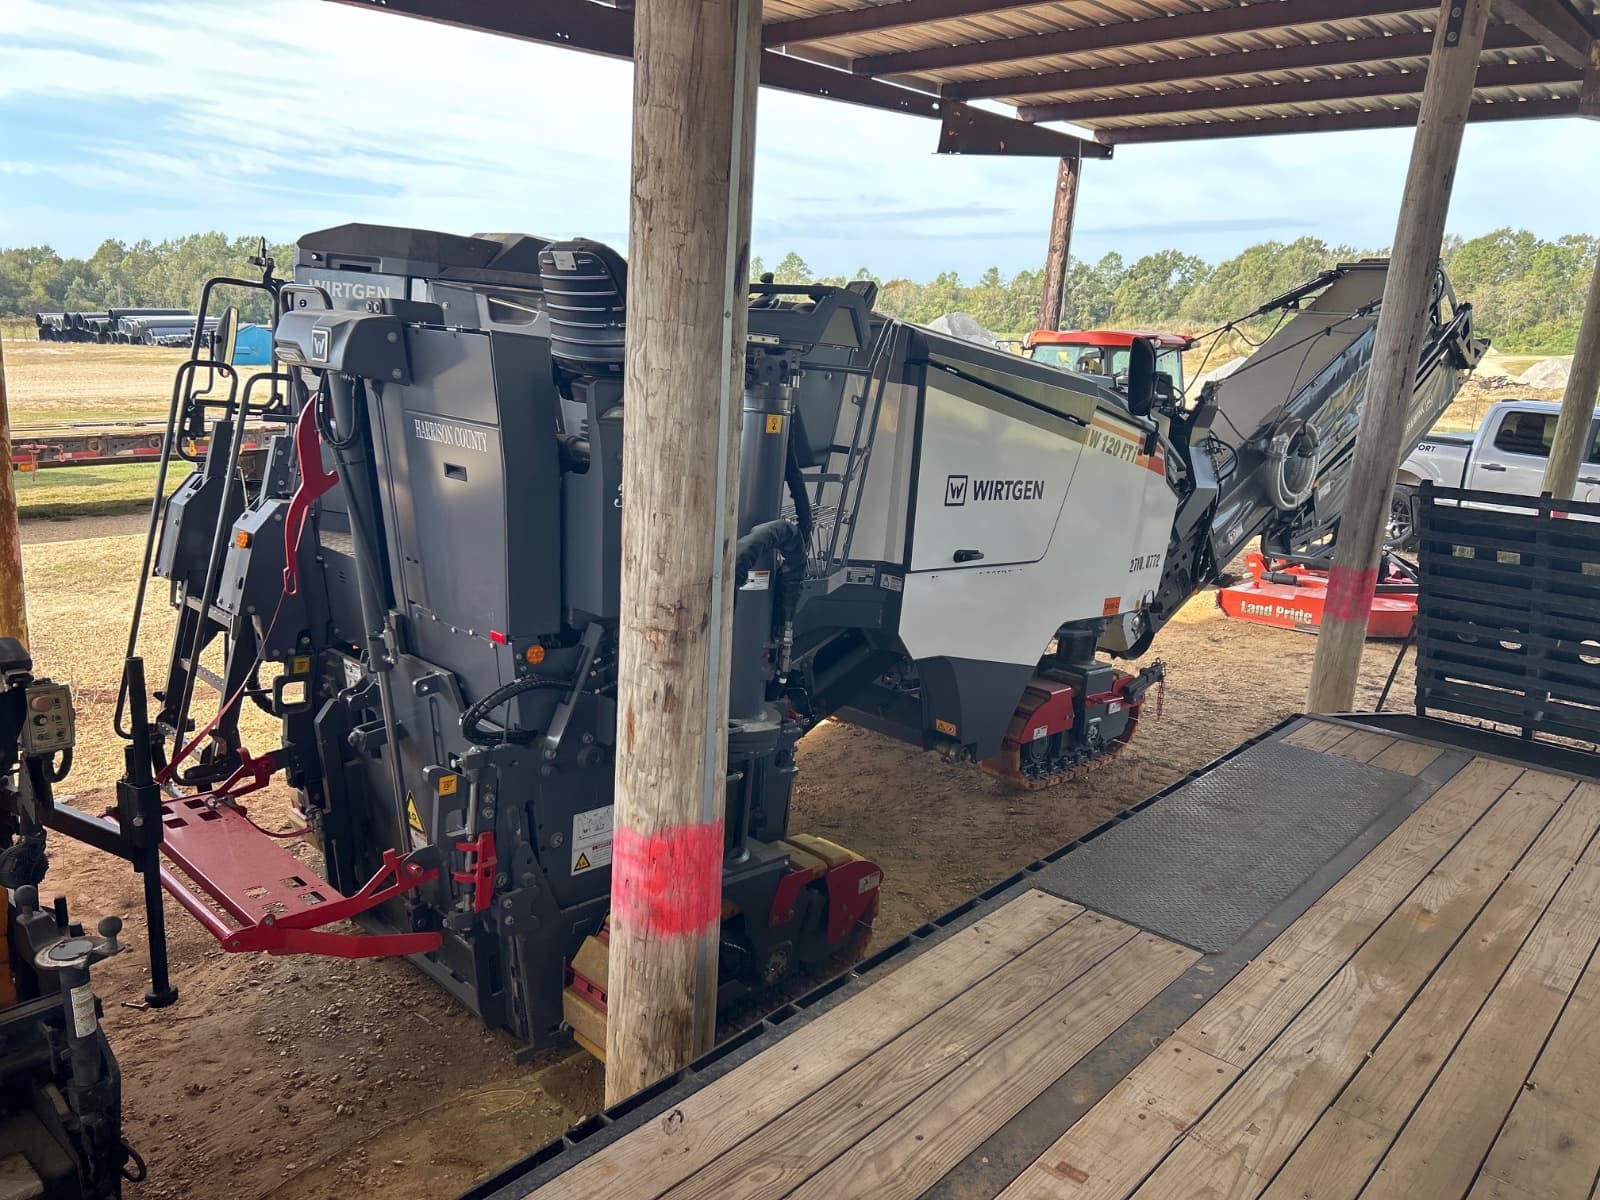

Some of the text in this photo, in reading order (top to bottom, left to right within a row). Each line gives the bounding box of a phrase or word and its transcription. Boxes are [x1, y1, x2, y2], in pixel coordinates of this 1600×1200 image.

[414, 419, 487, 453] HARRISON COUNTY
[1089, 429, 1101, 448] W
[1102, 434, 1121, 457] 120
[1418, 444, 1436, 453] ORT
[973, 480, 1044, 501] WIRTGEN
[1241, 600, 1313, 625] Land Pride
